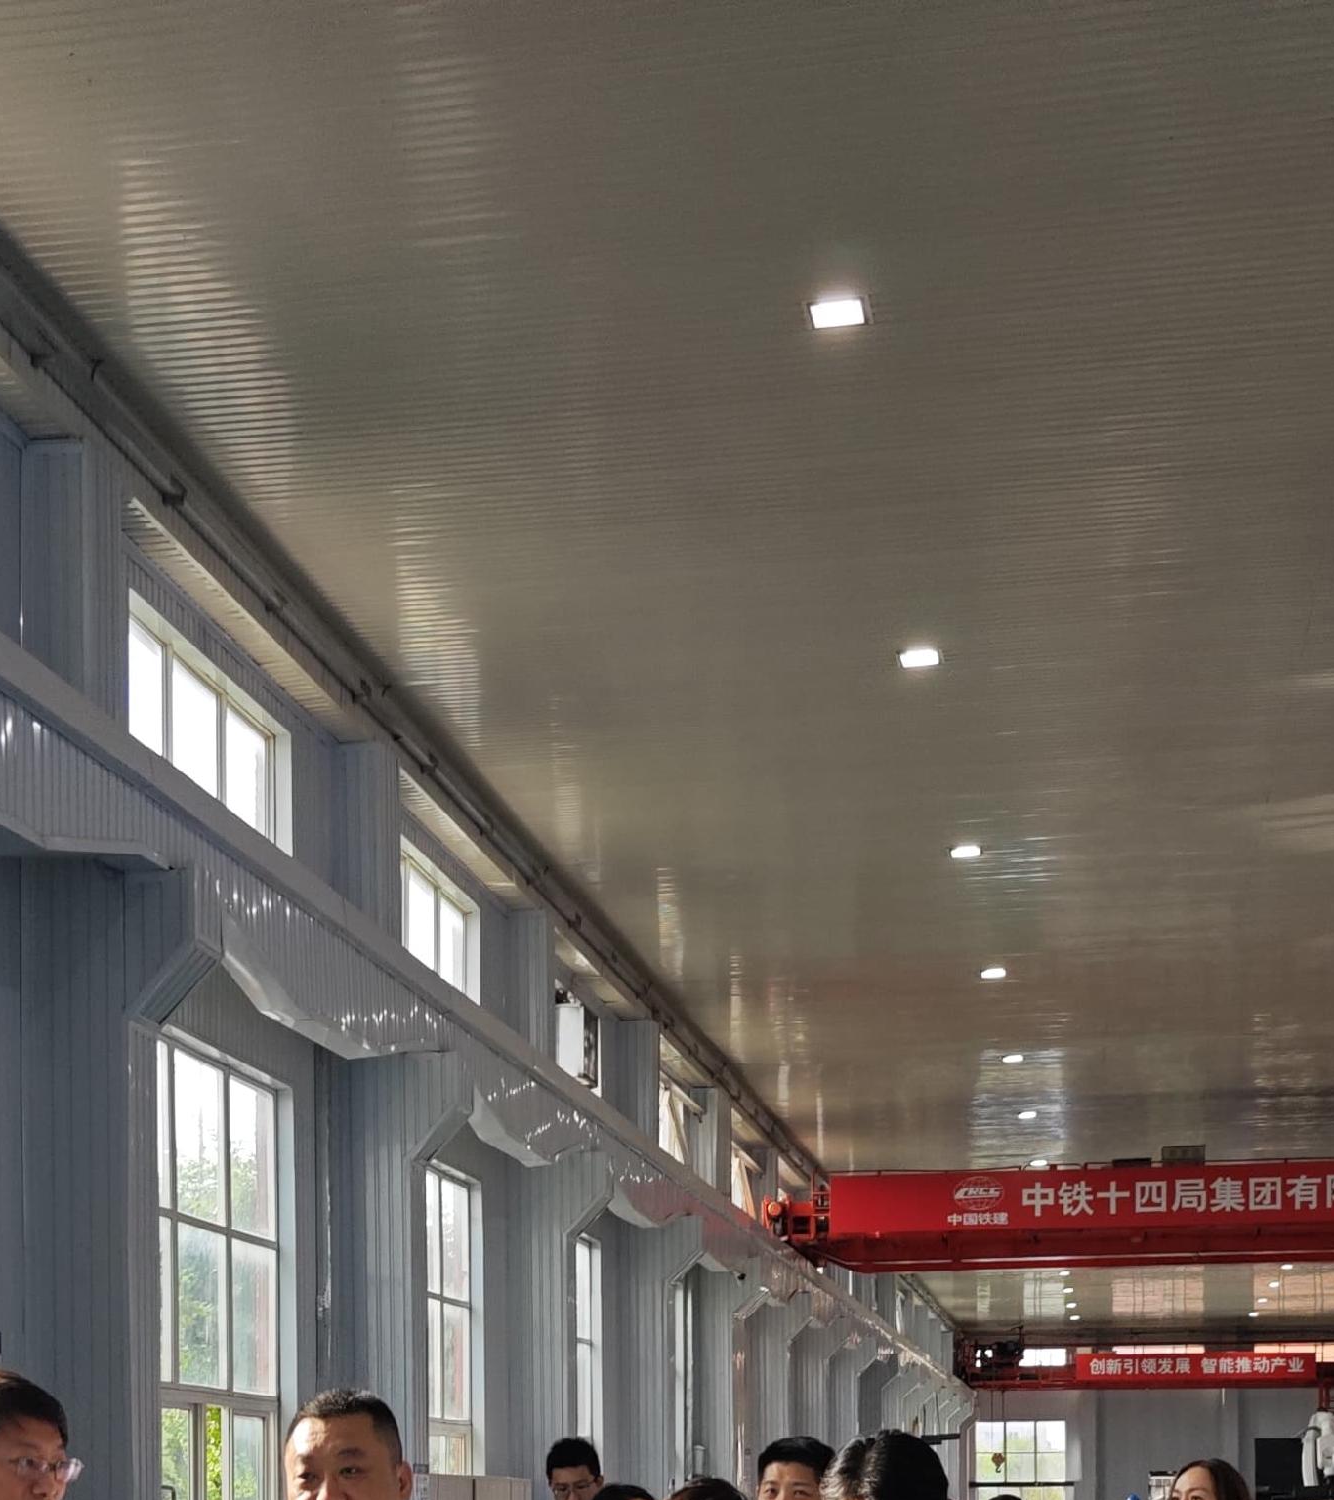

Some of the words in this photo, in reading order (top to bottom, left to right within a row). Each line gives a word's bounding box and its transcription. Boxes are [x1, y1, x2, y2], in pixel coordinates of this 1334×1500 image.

[947, 1212, 1009, 1226] 中国铁建
[1089, 1357, 1191, 1375] 创新引领发展
[1200, 1356, 1305, 1373] 智能推动产业
